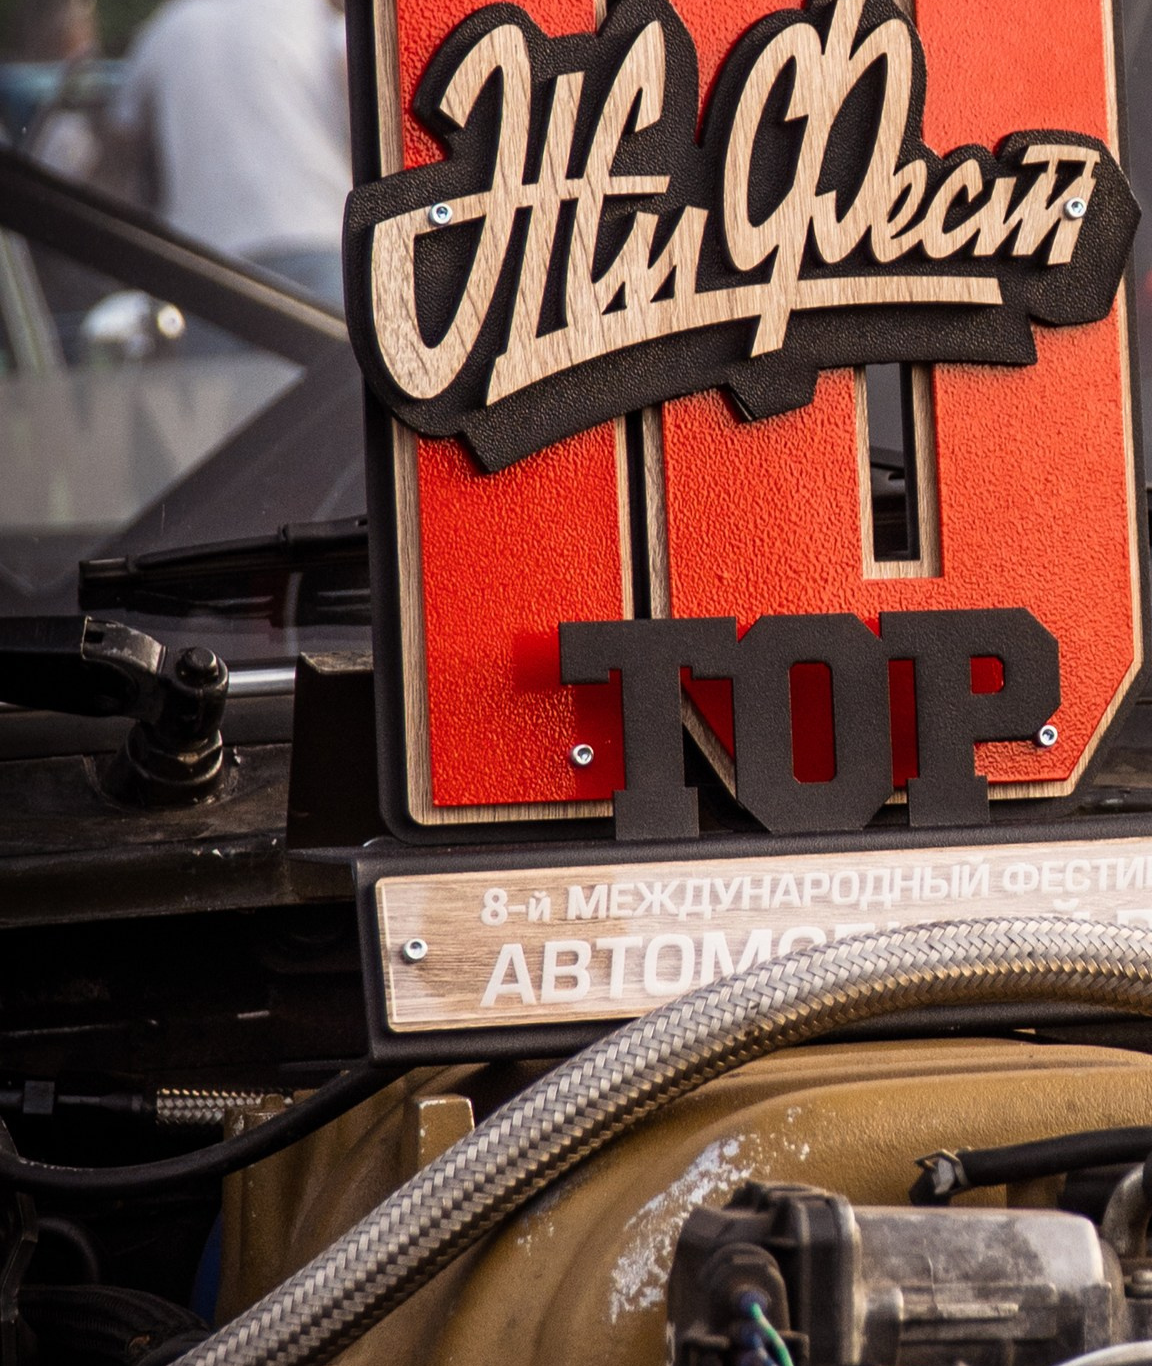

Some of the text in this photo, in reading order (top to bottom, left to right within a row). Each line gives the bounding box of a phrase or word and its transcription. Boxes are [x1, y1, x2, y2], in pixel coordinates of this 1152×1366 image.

[559, 607, 1060, 840] TOP
[480, 887, 551, 925] 8-й
[566, 856, 991, 922] МЕЖДУНАРОДНЫЙ
